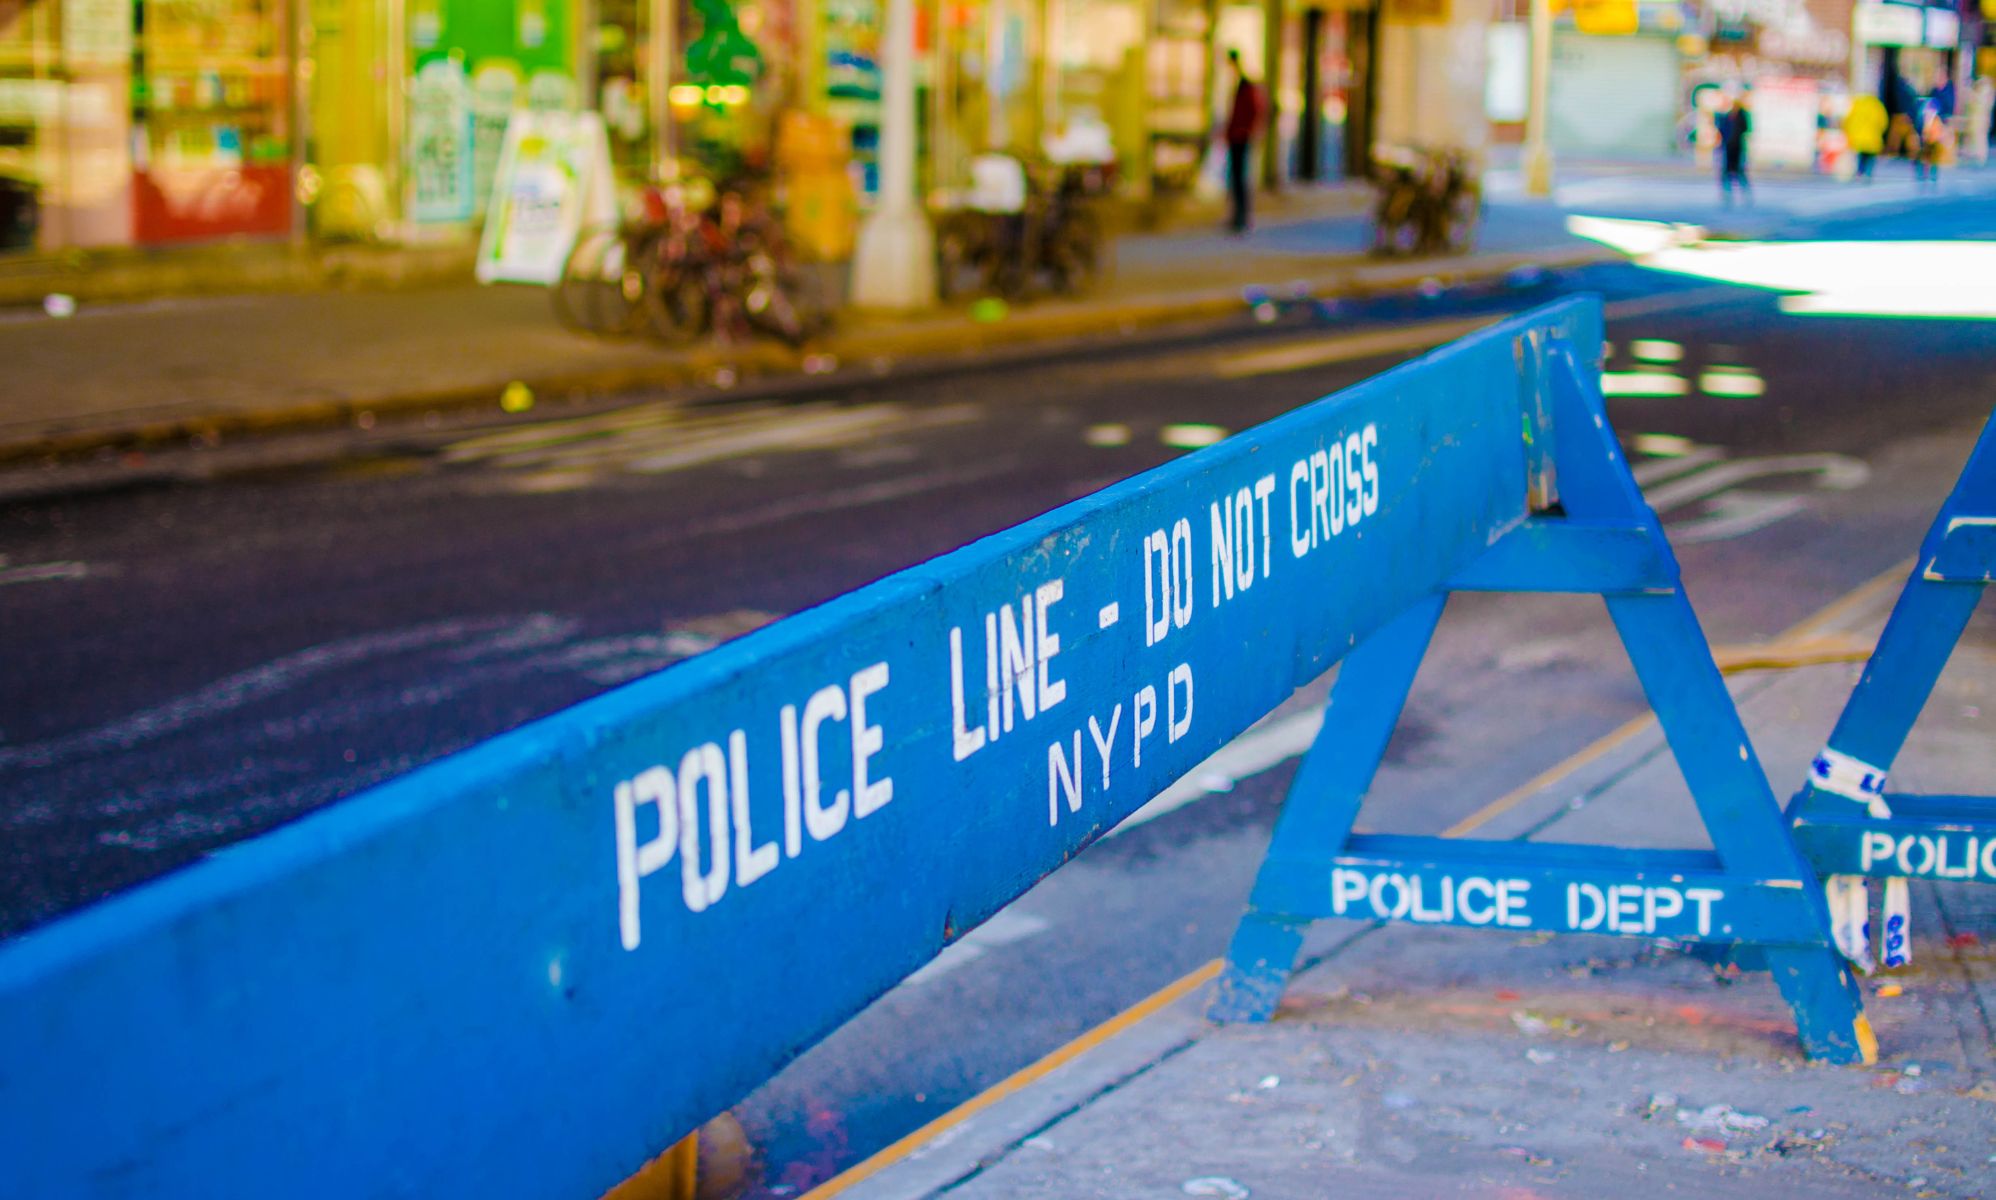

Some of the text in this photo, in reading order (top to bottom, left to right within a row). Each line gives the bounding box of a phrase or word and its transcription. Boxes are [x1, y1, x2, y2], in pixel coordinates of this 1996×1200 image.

[614, 661, 893, 951] POLICE
[949, 578, 1067, 762] LINE
[1143, 517, 1193, 648] DO
[1210, 473, 1276, 608] NOT
[1290, 423, 1379, 558] CROSS
[1048, 662, 1194, 827] NYPD
[1331, 867, 1732, 937] POLICE DEPT.
